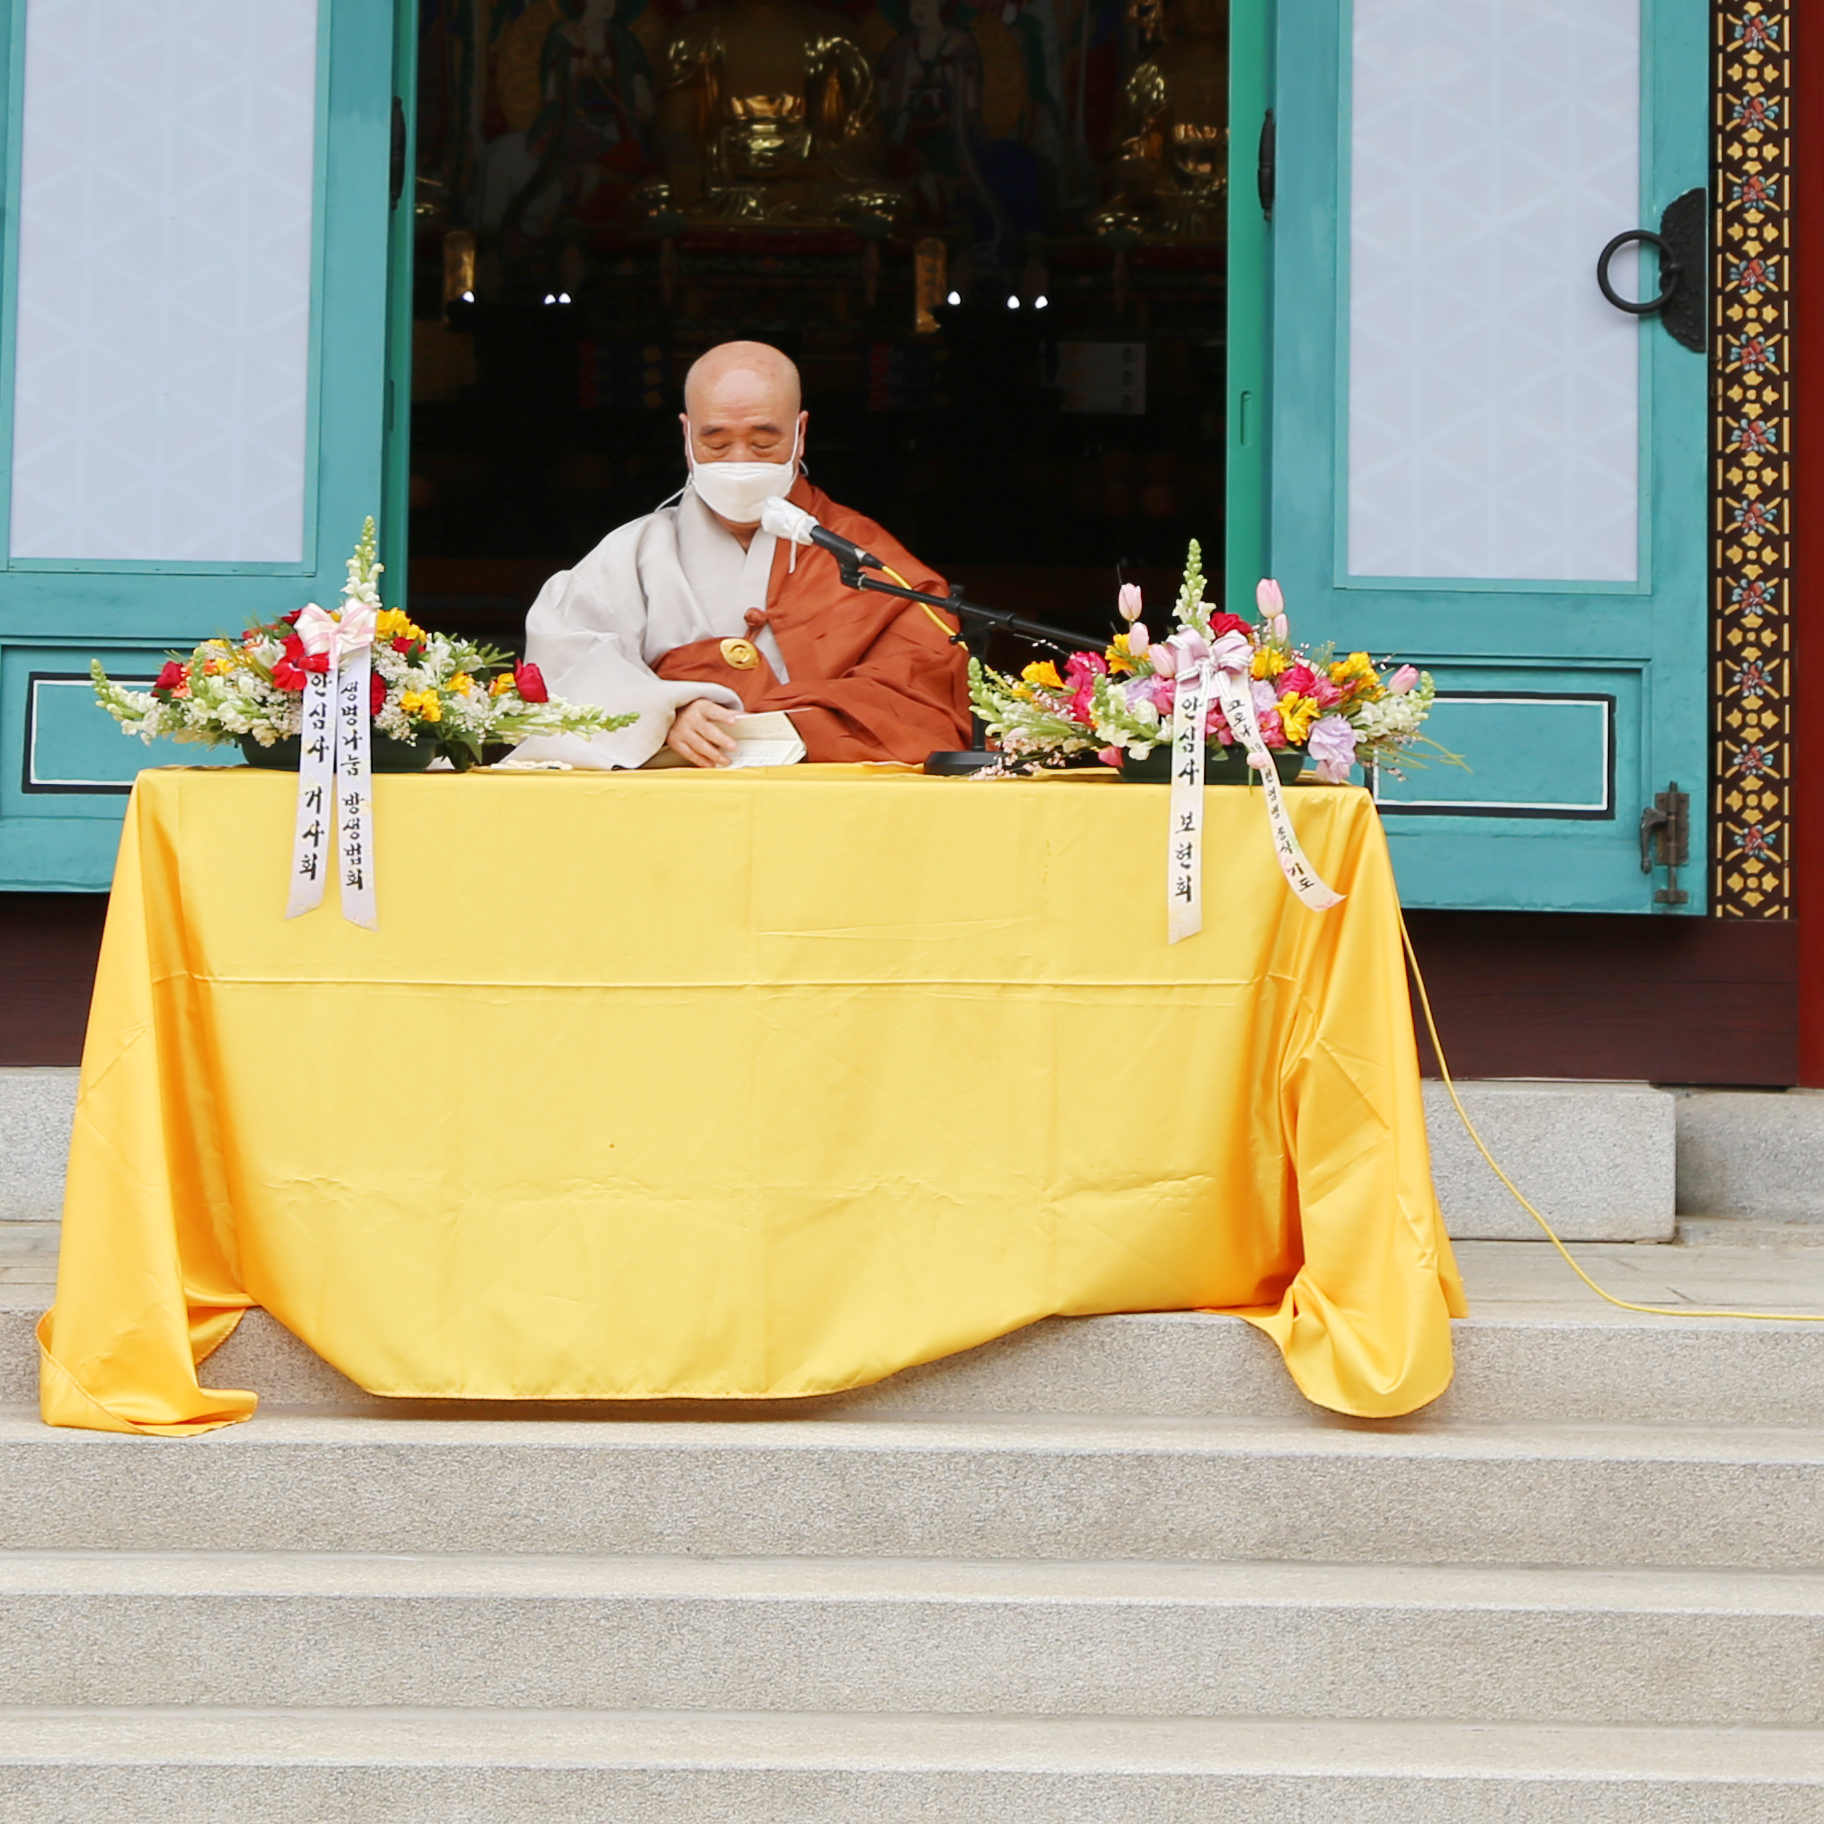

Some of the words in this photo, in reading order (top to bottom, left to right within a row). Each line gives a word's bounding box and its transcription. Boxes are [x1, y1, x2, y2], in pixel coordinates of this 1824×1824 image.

[307, 671, 333, 764] 안심사
[1178, 695, 1204, 786] 안심사
[299, 785, 325, 882] 거사회
[342, 791, 365, 891] 방생법회
[1174, 810, 1196, 904] 보현회
